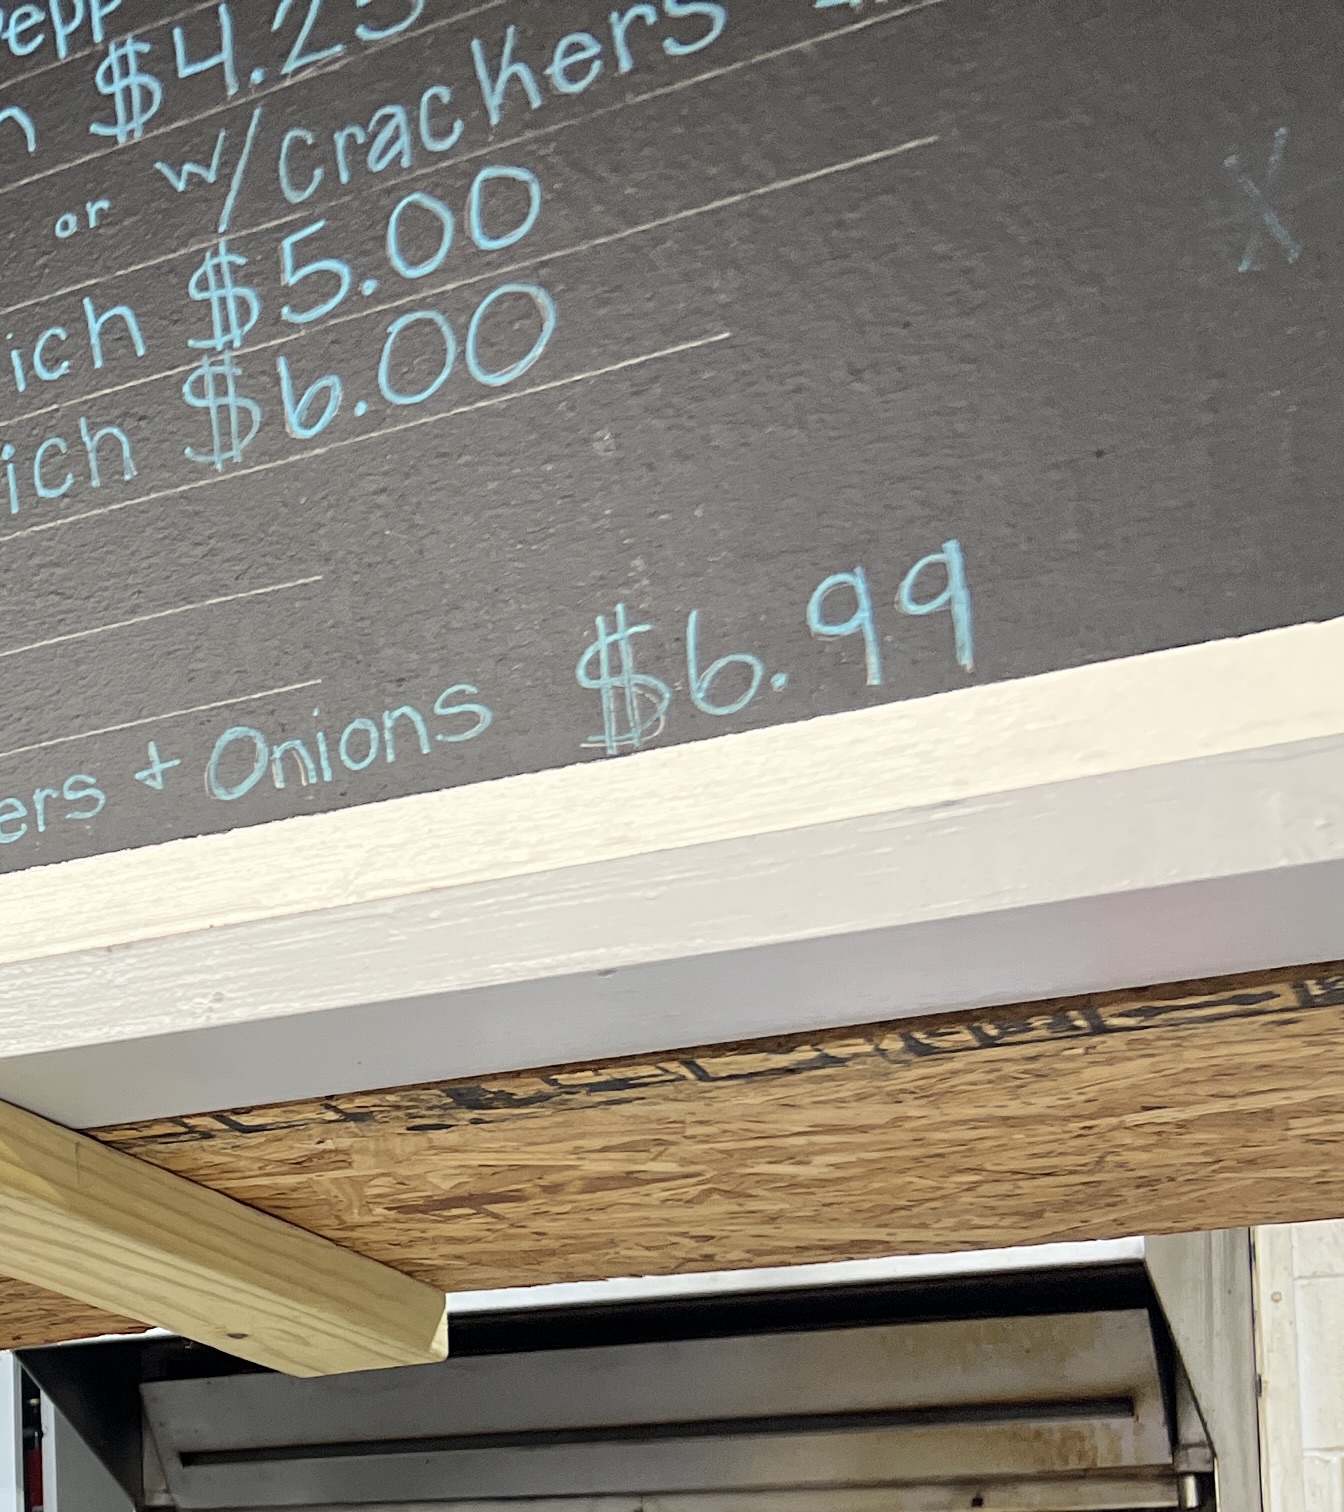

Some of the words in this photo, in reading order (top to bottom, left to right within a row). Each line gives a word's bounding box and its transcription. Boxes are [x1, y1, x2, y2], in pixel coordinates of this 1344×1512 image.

[55, 200, 110, 239] or
[188, 165, 542, 350] $5.00
[182, 283, 557, 470] $6.00
[205, 684, 494, 801] Onions
[576, 539, 973, 755] $6.99
